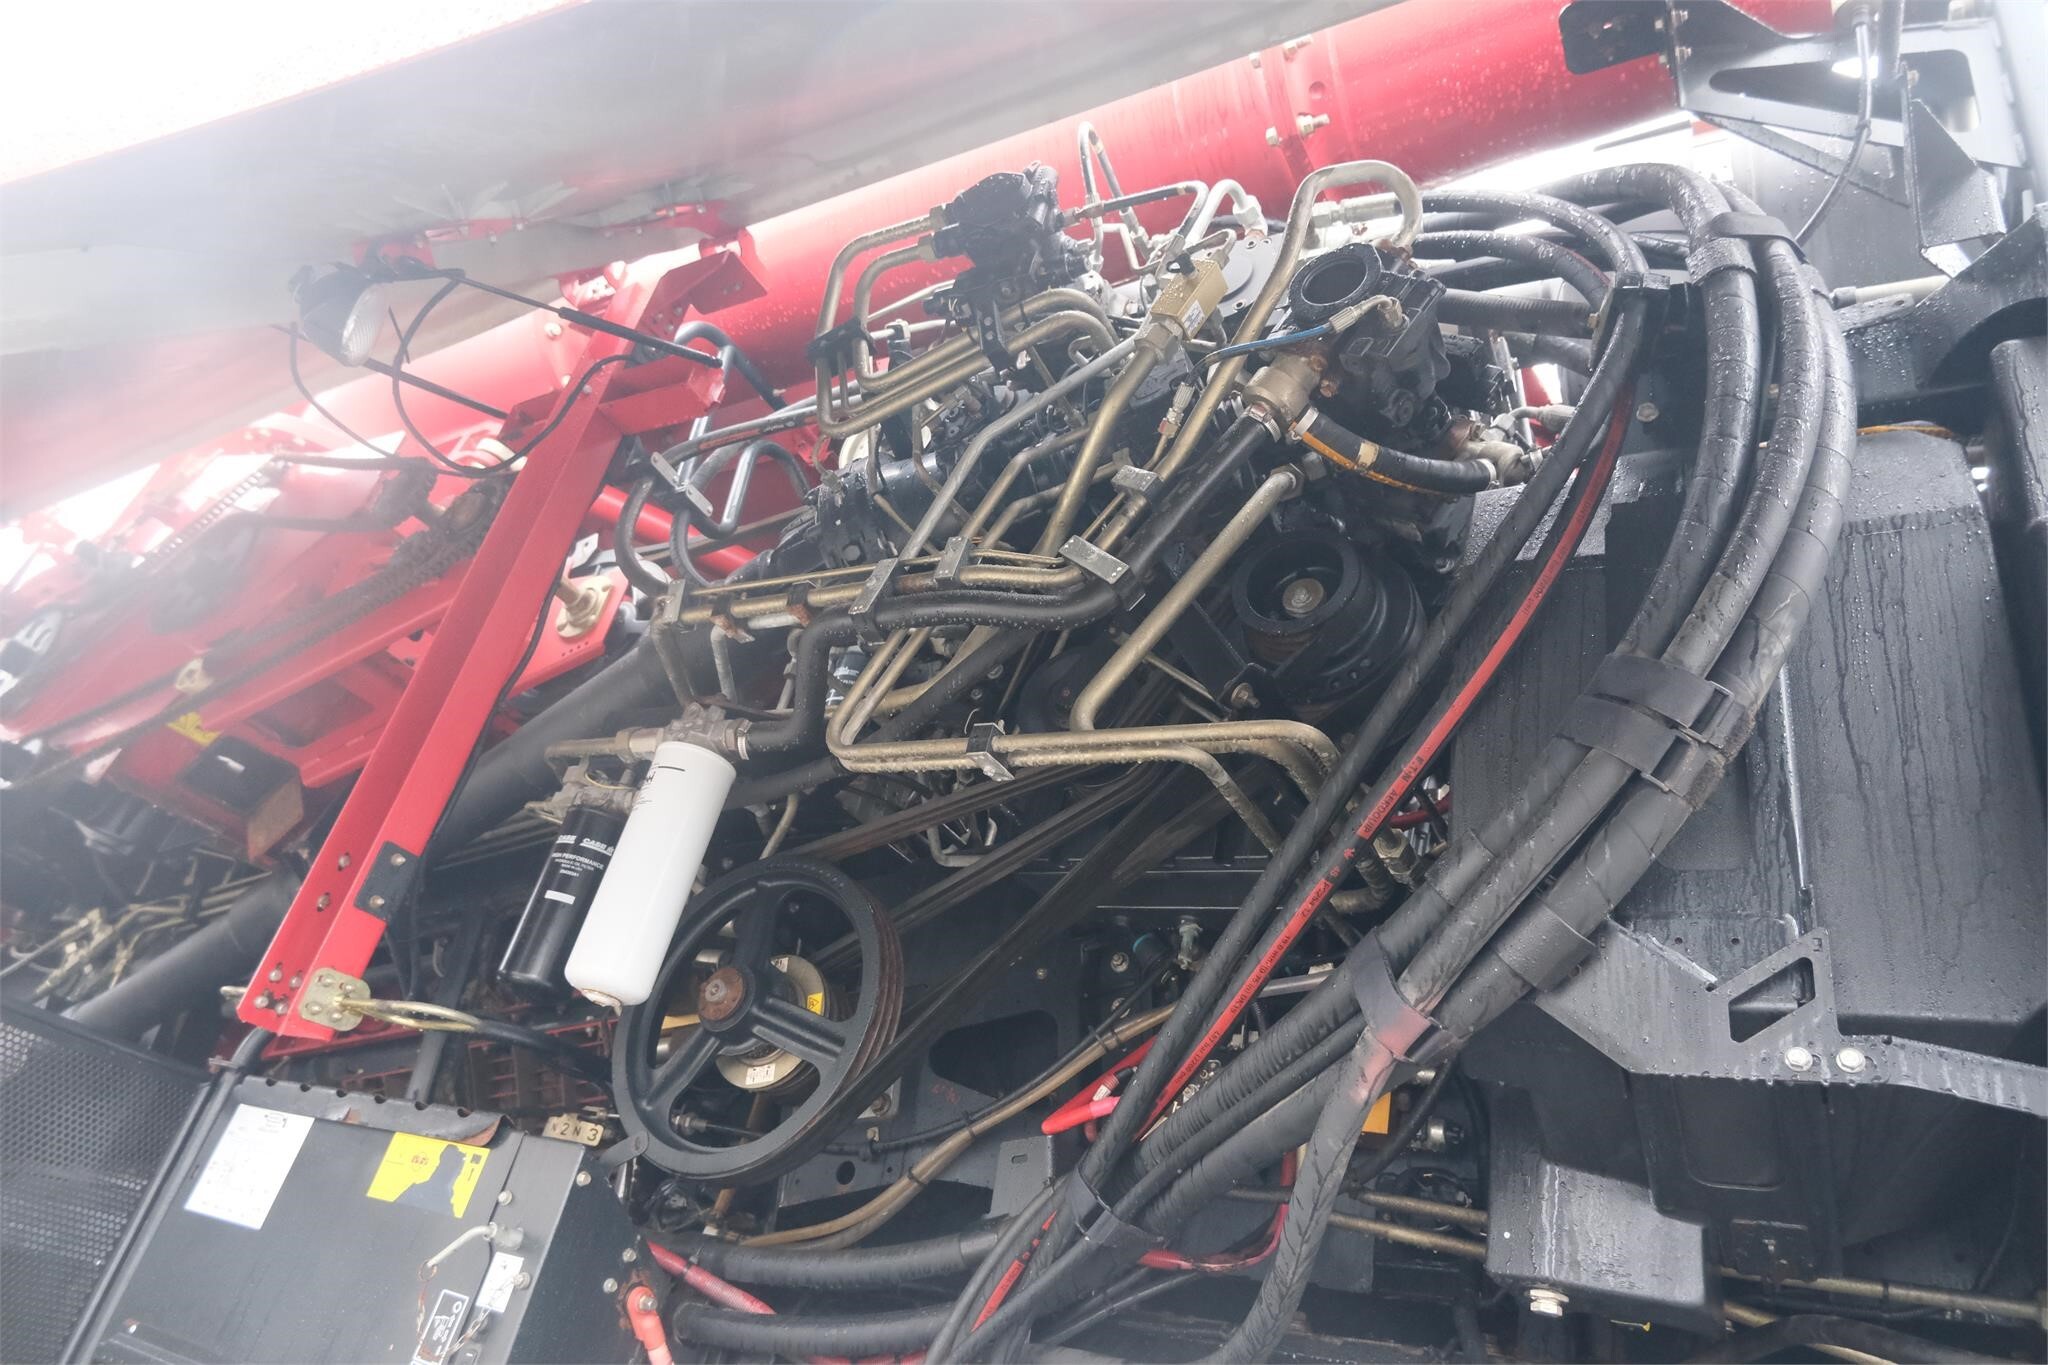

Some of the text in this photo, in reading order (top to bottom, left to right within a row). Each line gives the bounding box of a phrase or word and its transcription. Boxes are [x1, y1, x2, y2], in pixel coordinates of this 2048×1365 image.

[562, 852, 605, 871] PERFORMANCE
[559, 1122, 570, 1136] 2
[572, 1126, 582, 1137] N
[586, 1128, 599, 1142] 3
